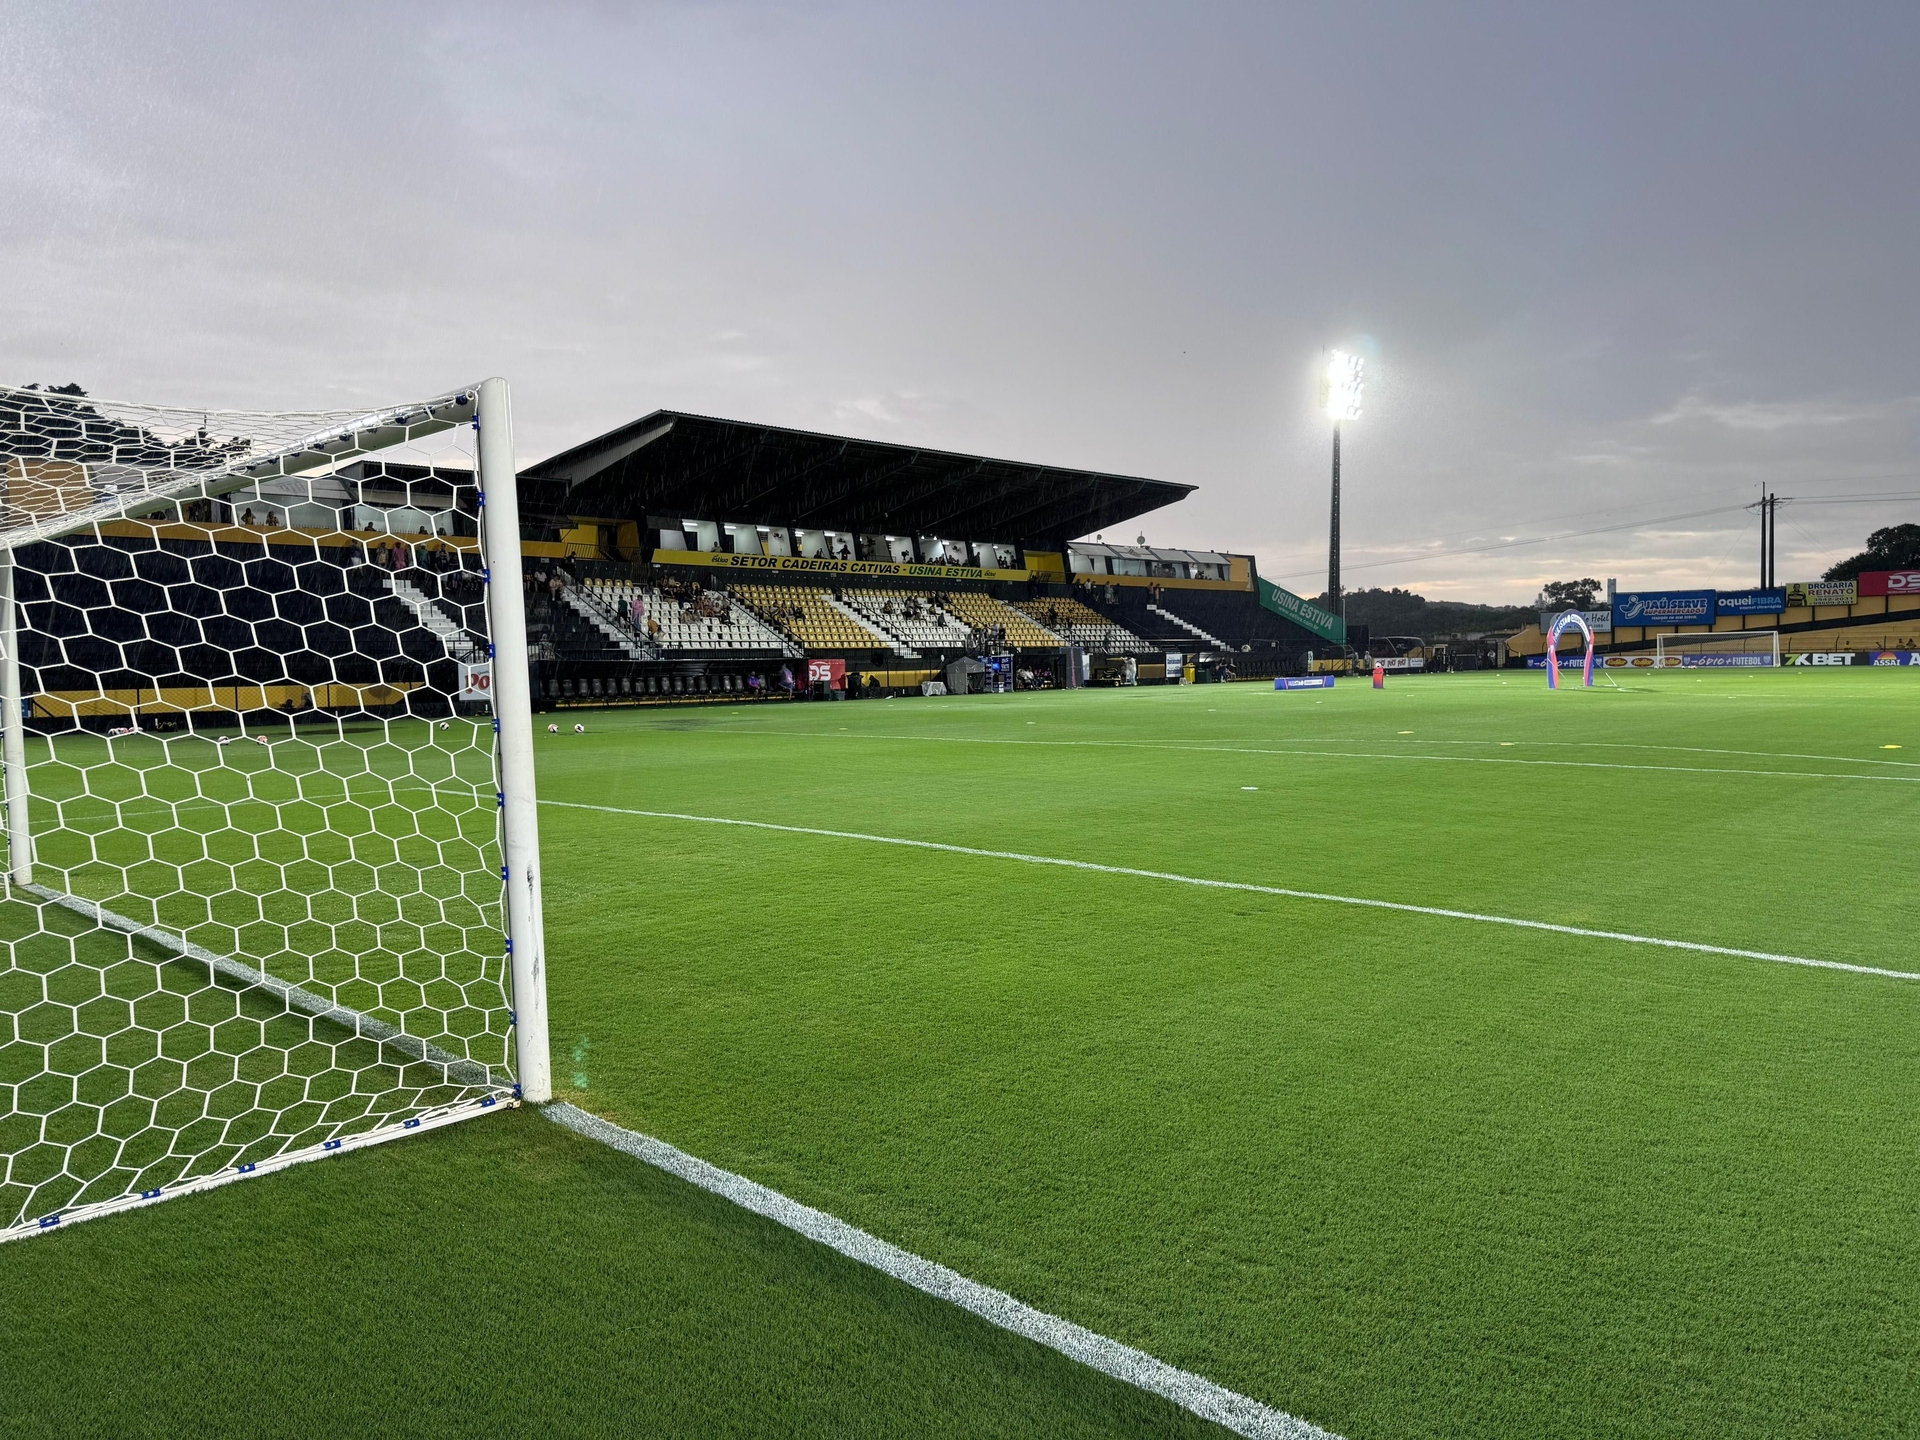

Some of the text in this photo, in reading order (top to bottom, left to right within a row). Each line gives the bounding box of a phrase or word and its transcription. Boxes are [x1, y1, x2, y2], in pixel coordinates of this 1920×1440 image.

[730, 556, 777, 568] SETOR
[782, 559, 847, 572] CADEIRAS
[850, 563, 900, 574] CATIVAS
[909, 566, 942, 576] USINA
[946, 568, 982, 578] ESTIVA
[1272, 588, 1334, 630] USINA ESTIVA
[1645, 597, 1707, 610] JAÚ SERVE
[1592, 613, 1610, 622] Hotel
[809, 665, 831, 681] DS
